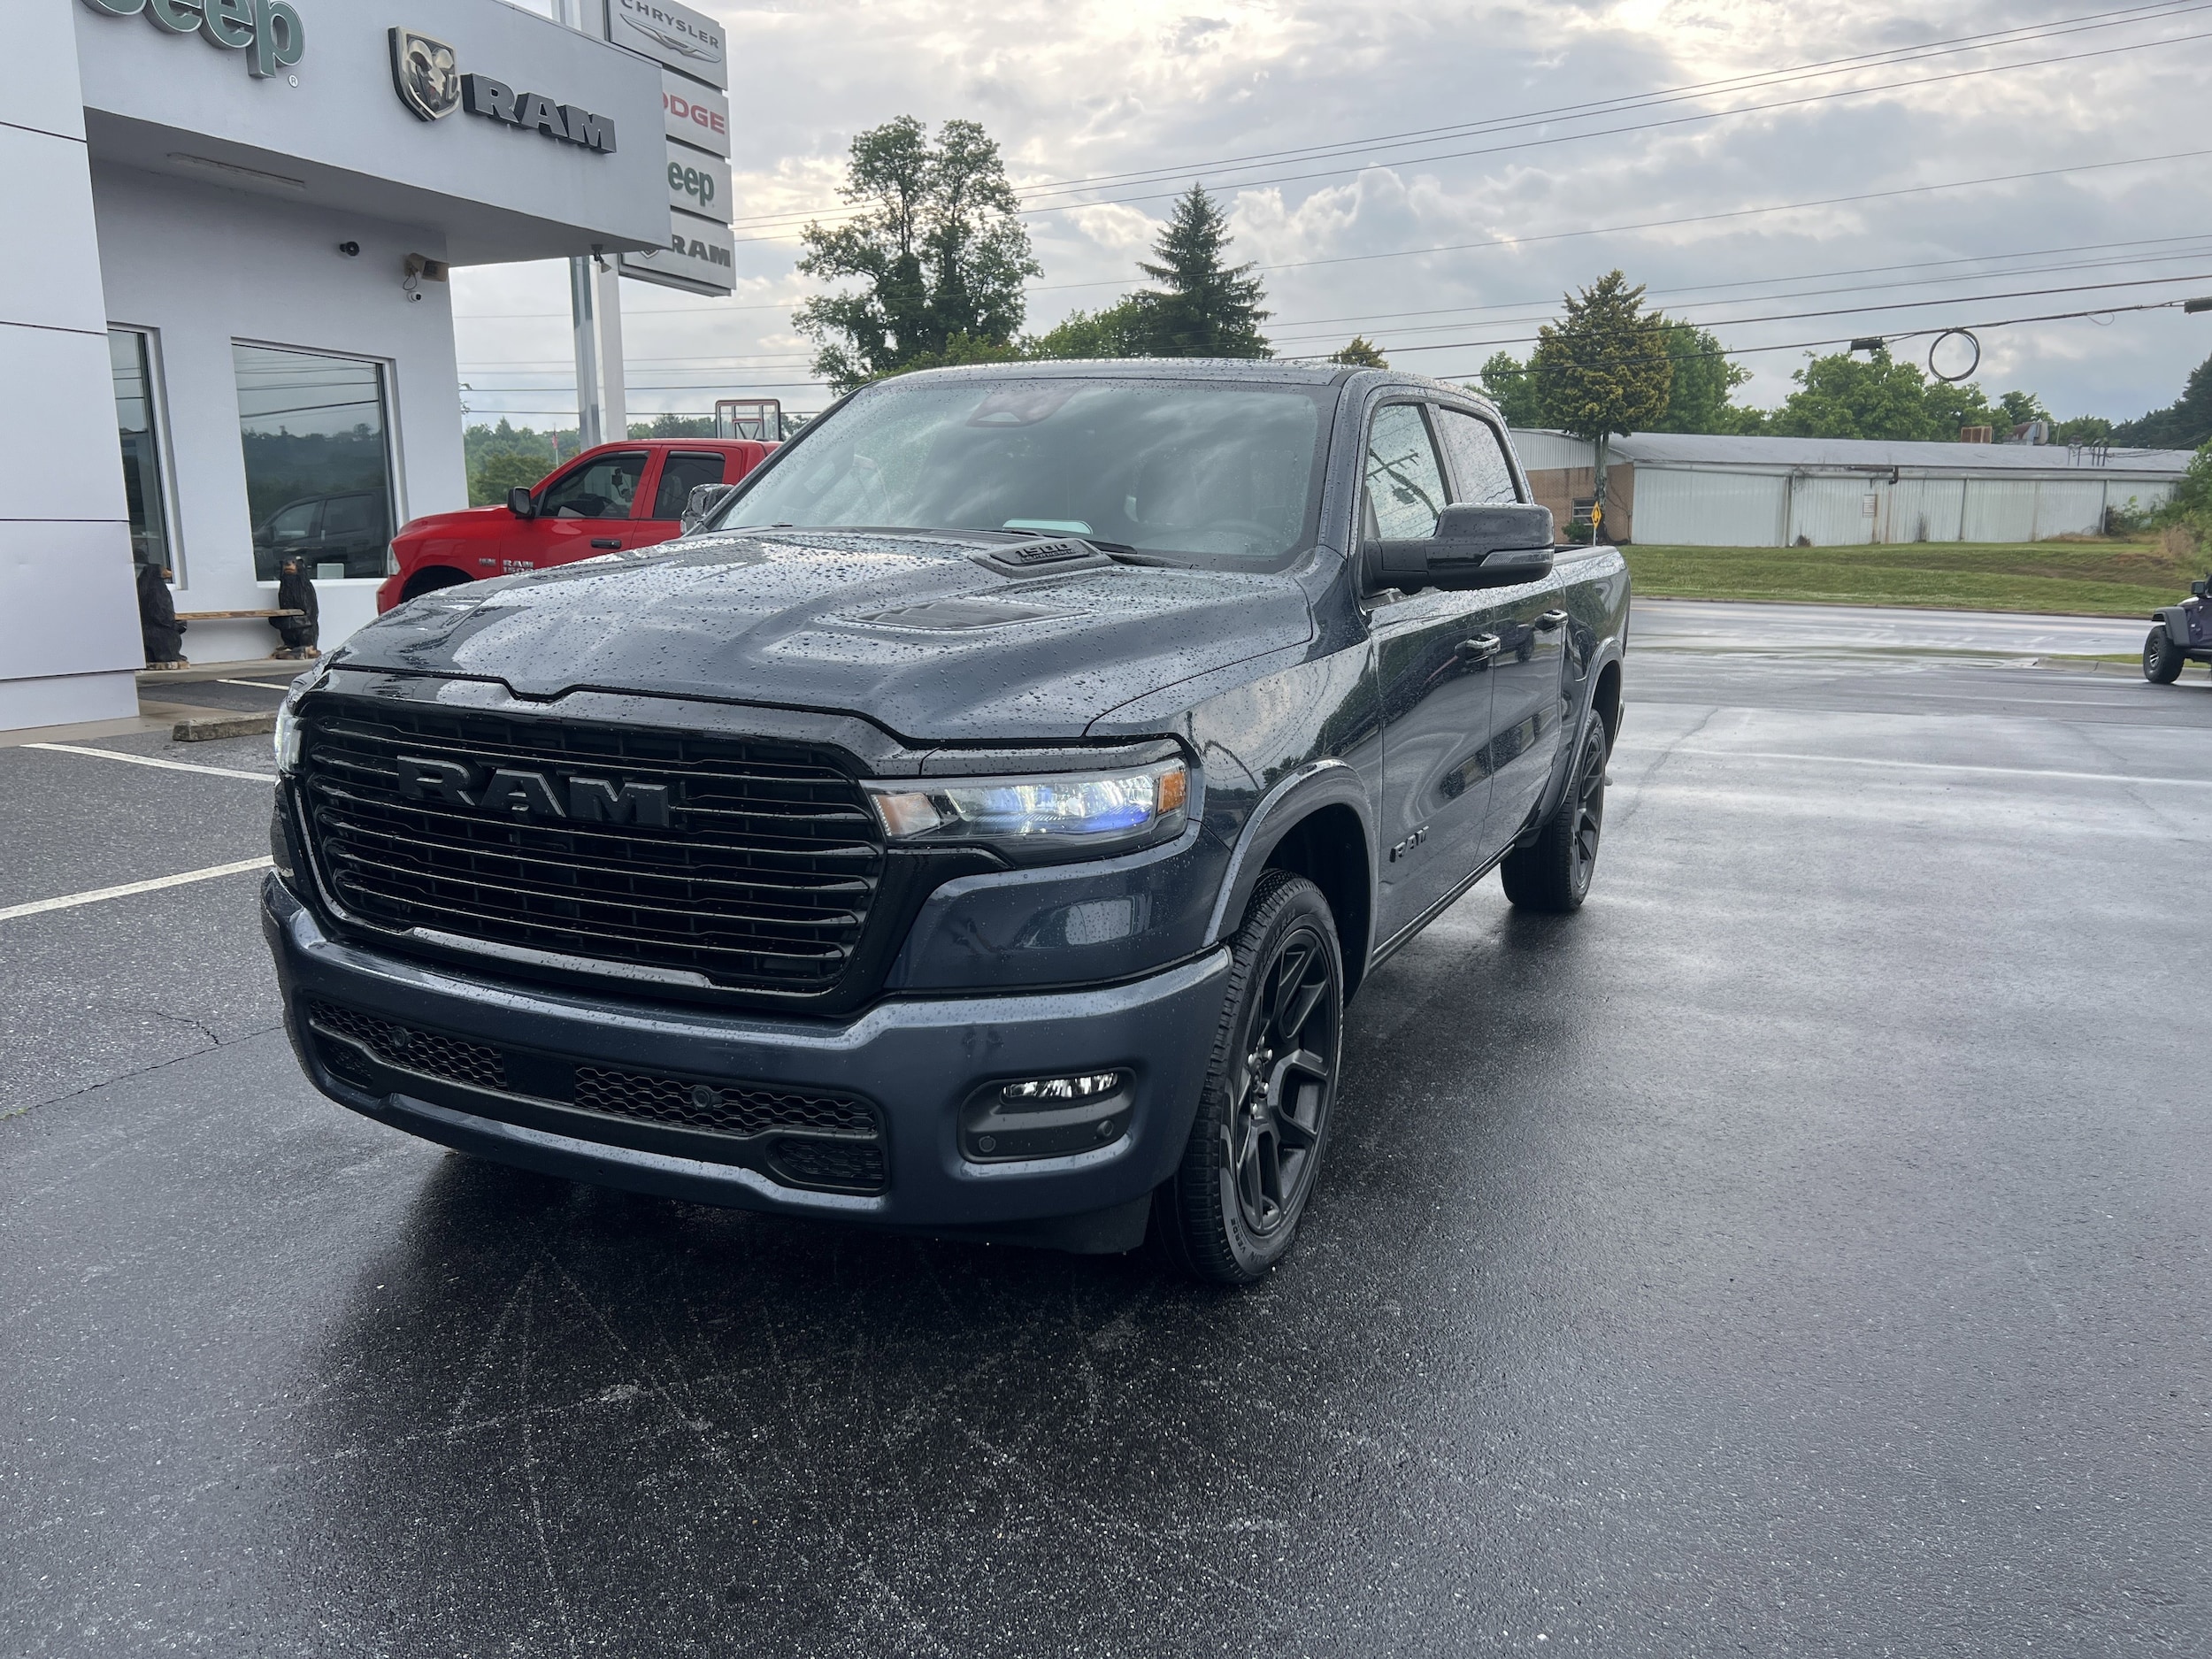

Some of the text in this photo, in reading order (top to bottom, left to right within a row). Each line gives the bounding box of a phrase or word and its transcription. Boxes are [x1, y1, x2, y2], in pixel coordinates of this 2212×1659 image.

[81, 0, 305, 78] eep
[621, 0, 719, 49] CHRYSLER
[460, 73, 617, 153] RAM
[662, 91, 726, 134] DGE
[667, 161, 715, 207] eep
[672, 234, 732, 268] RAM
[503, 559, 534, 568] RAM
[1016, 543, 1071, 557] 1500
[396, 755, 671, 829] RAM
